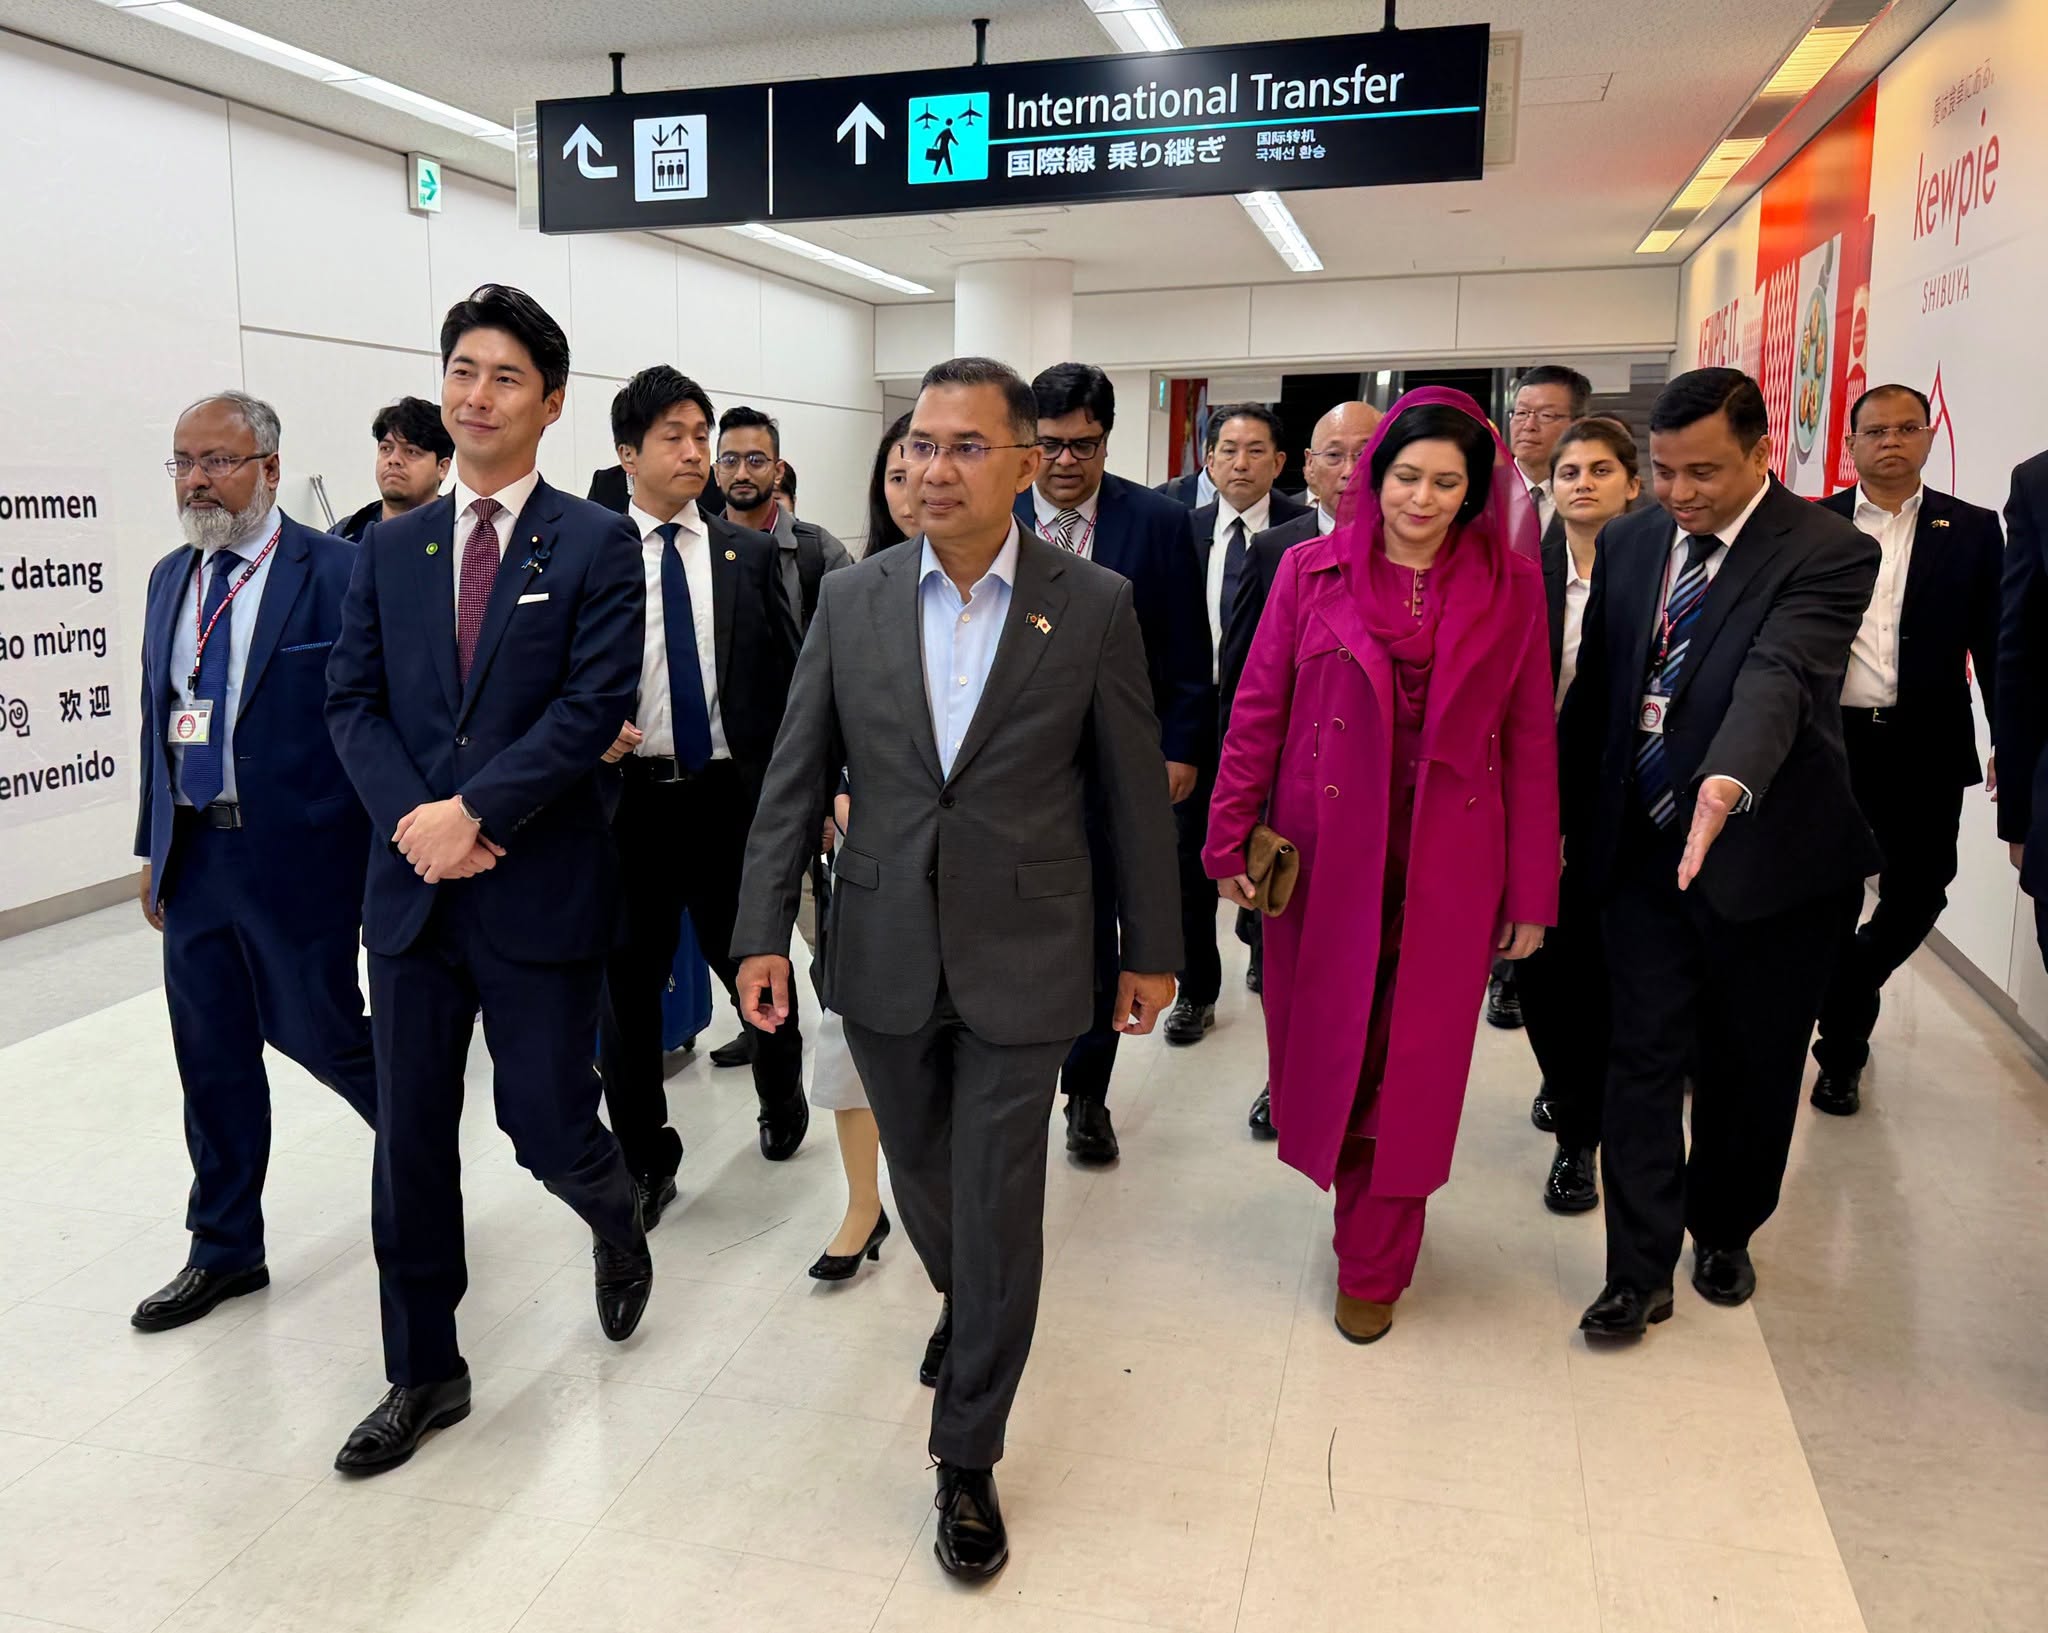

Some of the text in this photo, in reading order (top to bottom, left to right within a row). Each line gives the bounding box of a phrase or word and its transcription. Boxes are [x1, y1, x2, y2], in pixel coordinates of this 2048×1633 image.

[1007, 63, 1405, 130] International Transfer
[1007, 135, 1227, 178] 国際線 乗り継ぎ
[1255, 144, 1327, 162] 국제선 환승
[1256, 129, 1317, 146] 国际转机
[1914, 109, 2000, 246] kewpie
[1921, 264, 1970, 315] SHIBUYA
[0, 495, 97, 520] ommen
[11, 556, 104, 594] datang
[33, 622, 107, 659] mừng
[58, 685, 112, 723] 欢迎
[0, 750, 115, 800] envenido
